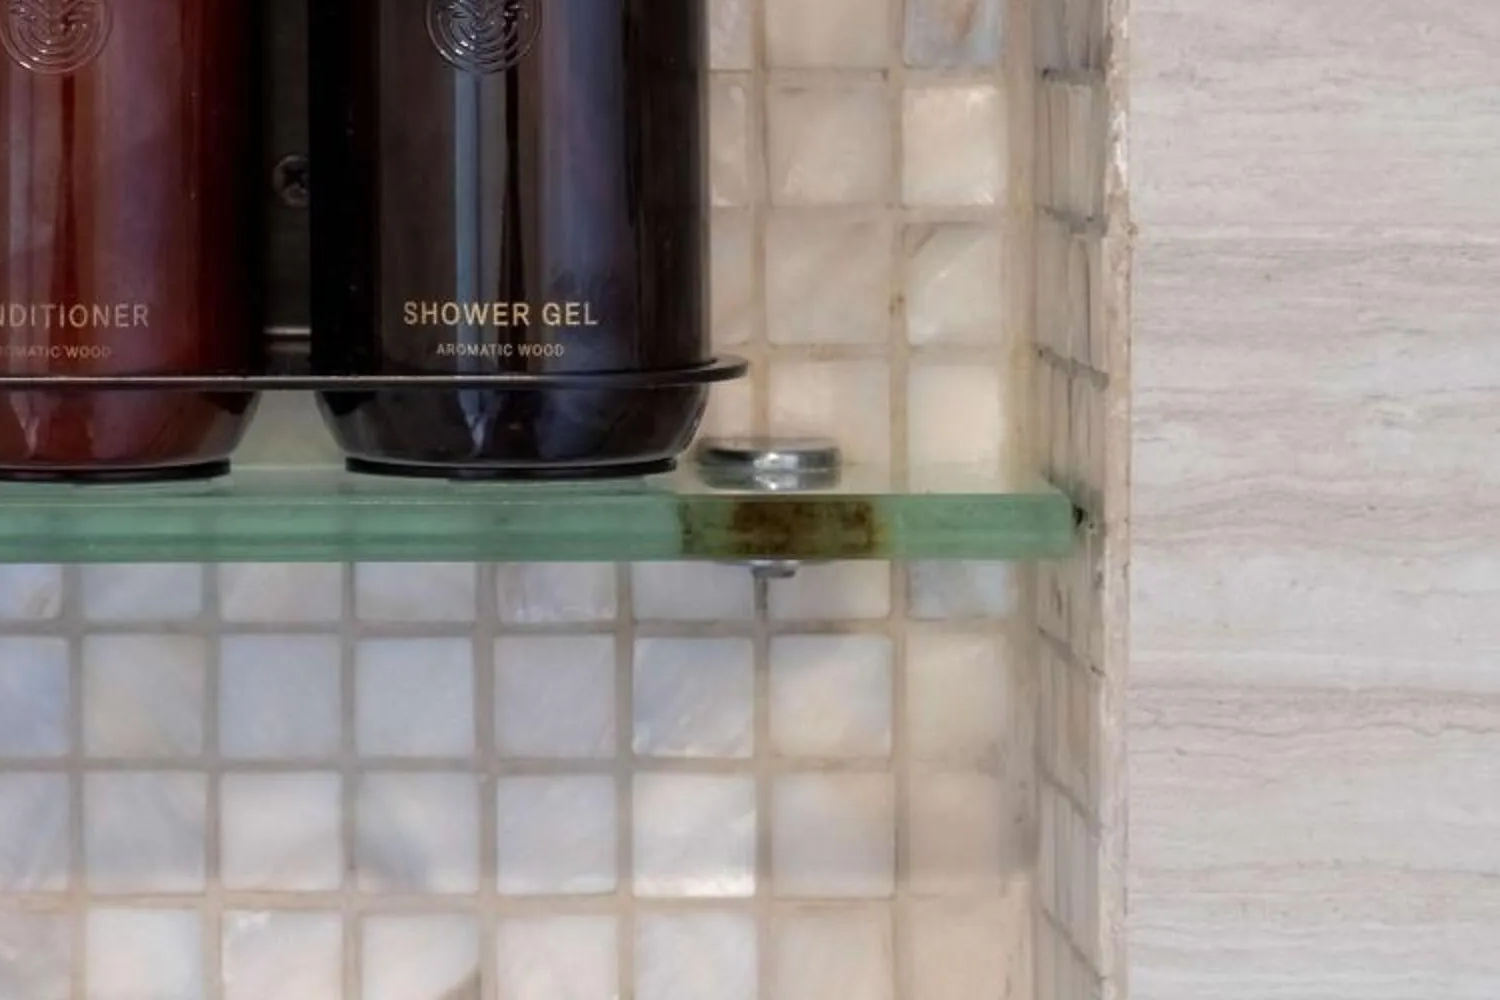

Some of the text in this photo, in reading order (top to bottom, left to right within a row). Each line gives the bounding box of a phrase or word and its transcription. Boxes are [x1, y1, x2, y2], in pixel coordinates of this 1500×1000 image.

[403, 301, 599, 327] SHOWER GEL
[64, 345, 112, 359] WOOD
[436, 343, 566, 358] AROMATIC WOOD
